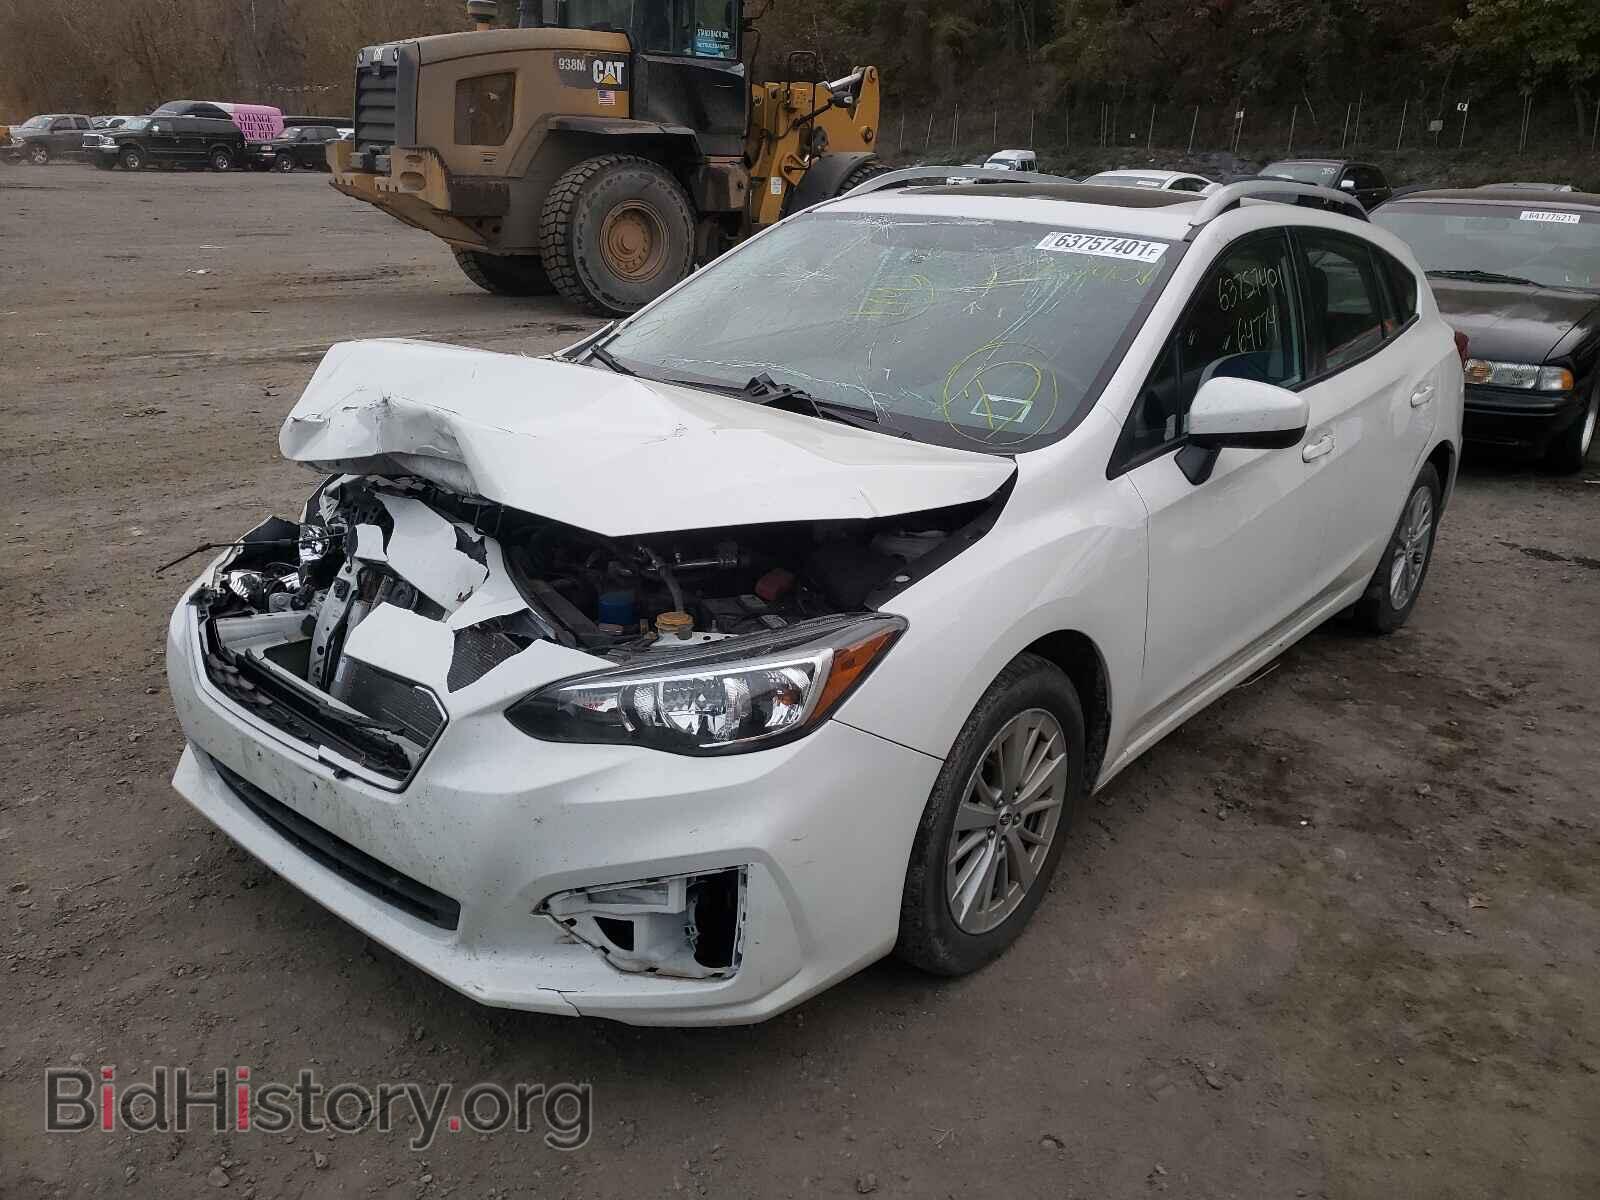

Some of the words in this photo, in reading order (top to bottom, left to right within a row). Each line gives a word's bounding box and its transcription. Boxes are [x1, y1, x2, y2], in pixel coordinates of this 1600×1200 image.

[558, 57, 586, 72] 938M
[592, 59, 625, 85] CAT
[238, 112, 271, 123] CHANGE
[239, 121, 255, 131] THE
[257, 122, 274, 133] WAY
[1218, 264, 1286, 311] 63757401
